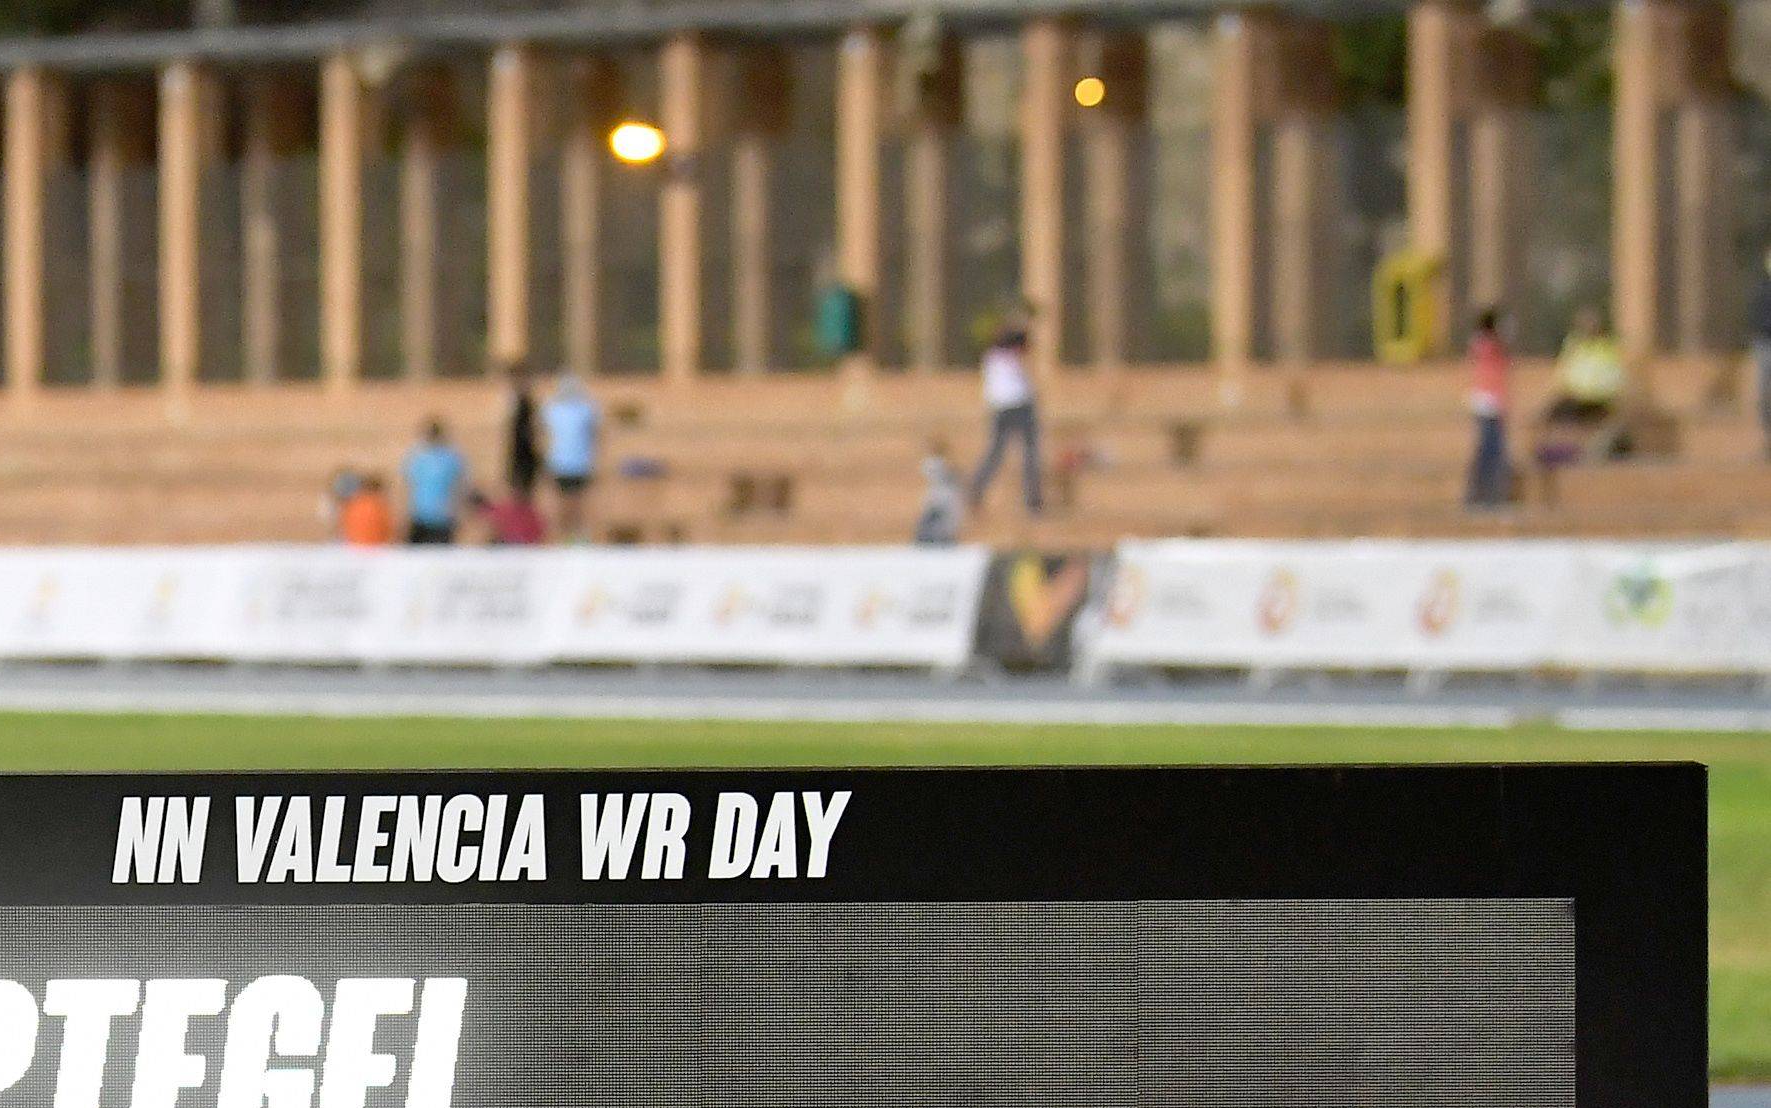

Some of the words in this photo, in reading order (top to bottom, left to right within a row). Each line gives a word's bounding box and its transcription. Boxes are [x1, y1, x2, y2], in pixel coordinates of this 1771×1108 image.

[111, 796, 211, 884] NN
[235, 794, 547, 883] VALENCIA
[580, 792, 691, 880] WR
[707, 790, 853, 879] DAY
